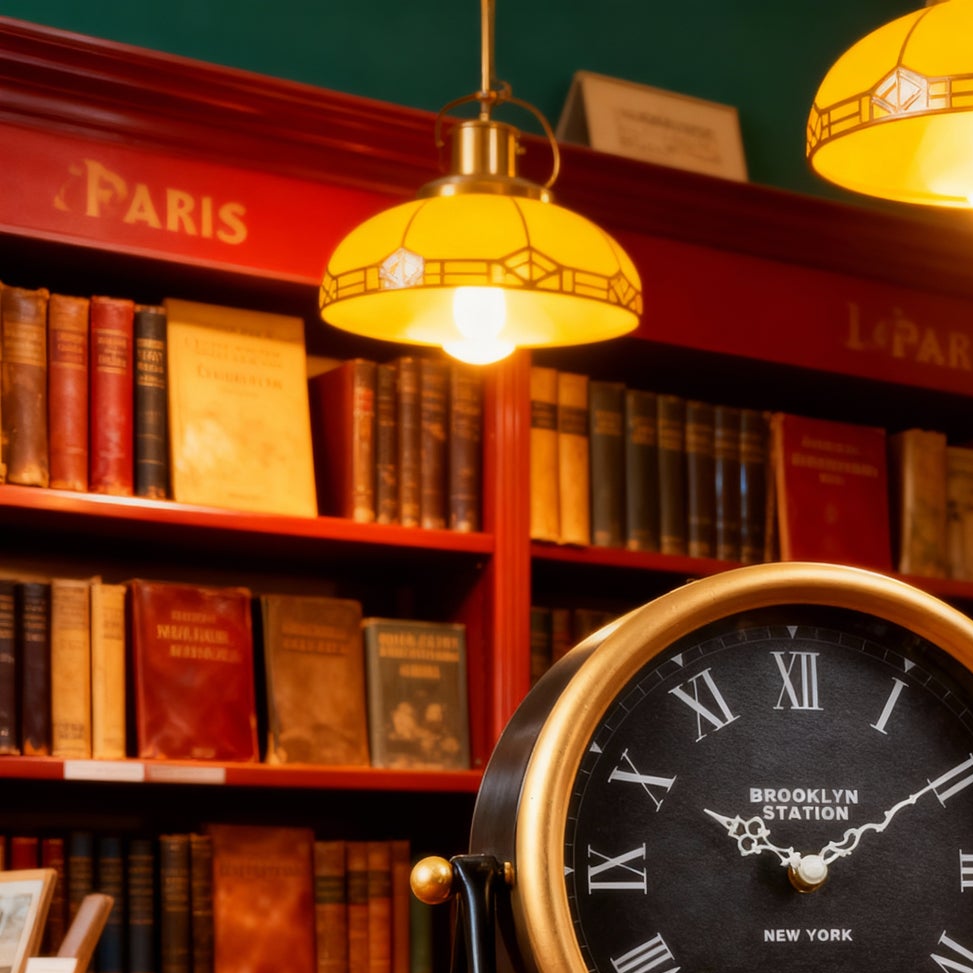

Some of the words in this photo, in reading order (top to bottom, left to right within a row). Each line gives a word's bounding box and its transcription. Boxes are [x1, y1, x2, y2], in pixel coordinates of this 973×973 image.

[668, 667, 741, 742] XI
[770, 651, 824, 710] XII
[870, 677, 909, 735] I
[608, 748, 677, 812] X
[750, 787, 858, 804] BROOKLYN
[762, 805, 849, 820] STATION
[587, 842, 647, 895] IX
[764, 929, 800, 942] NEW
[806, 929, 853, 942] YORK
